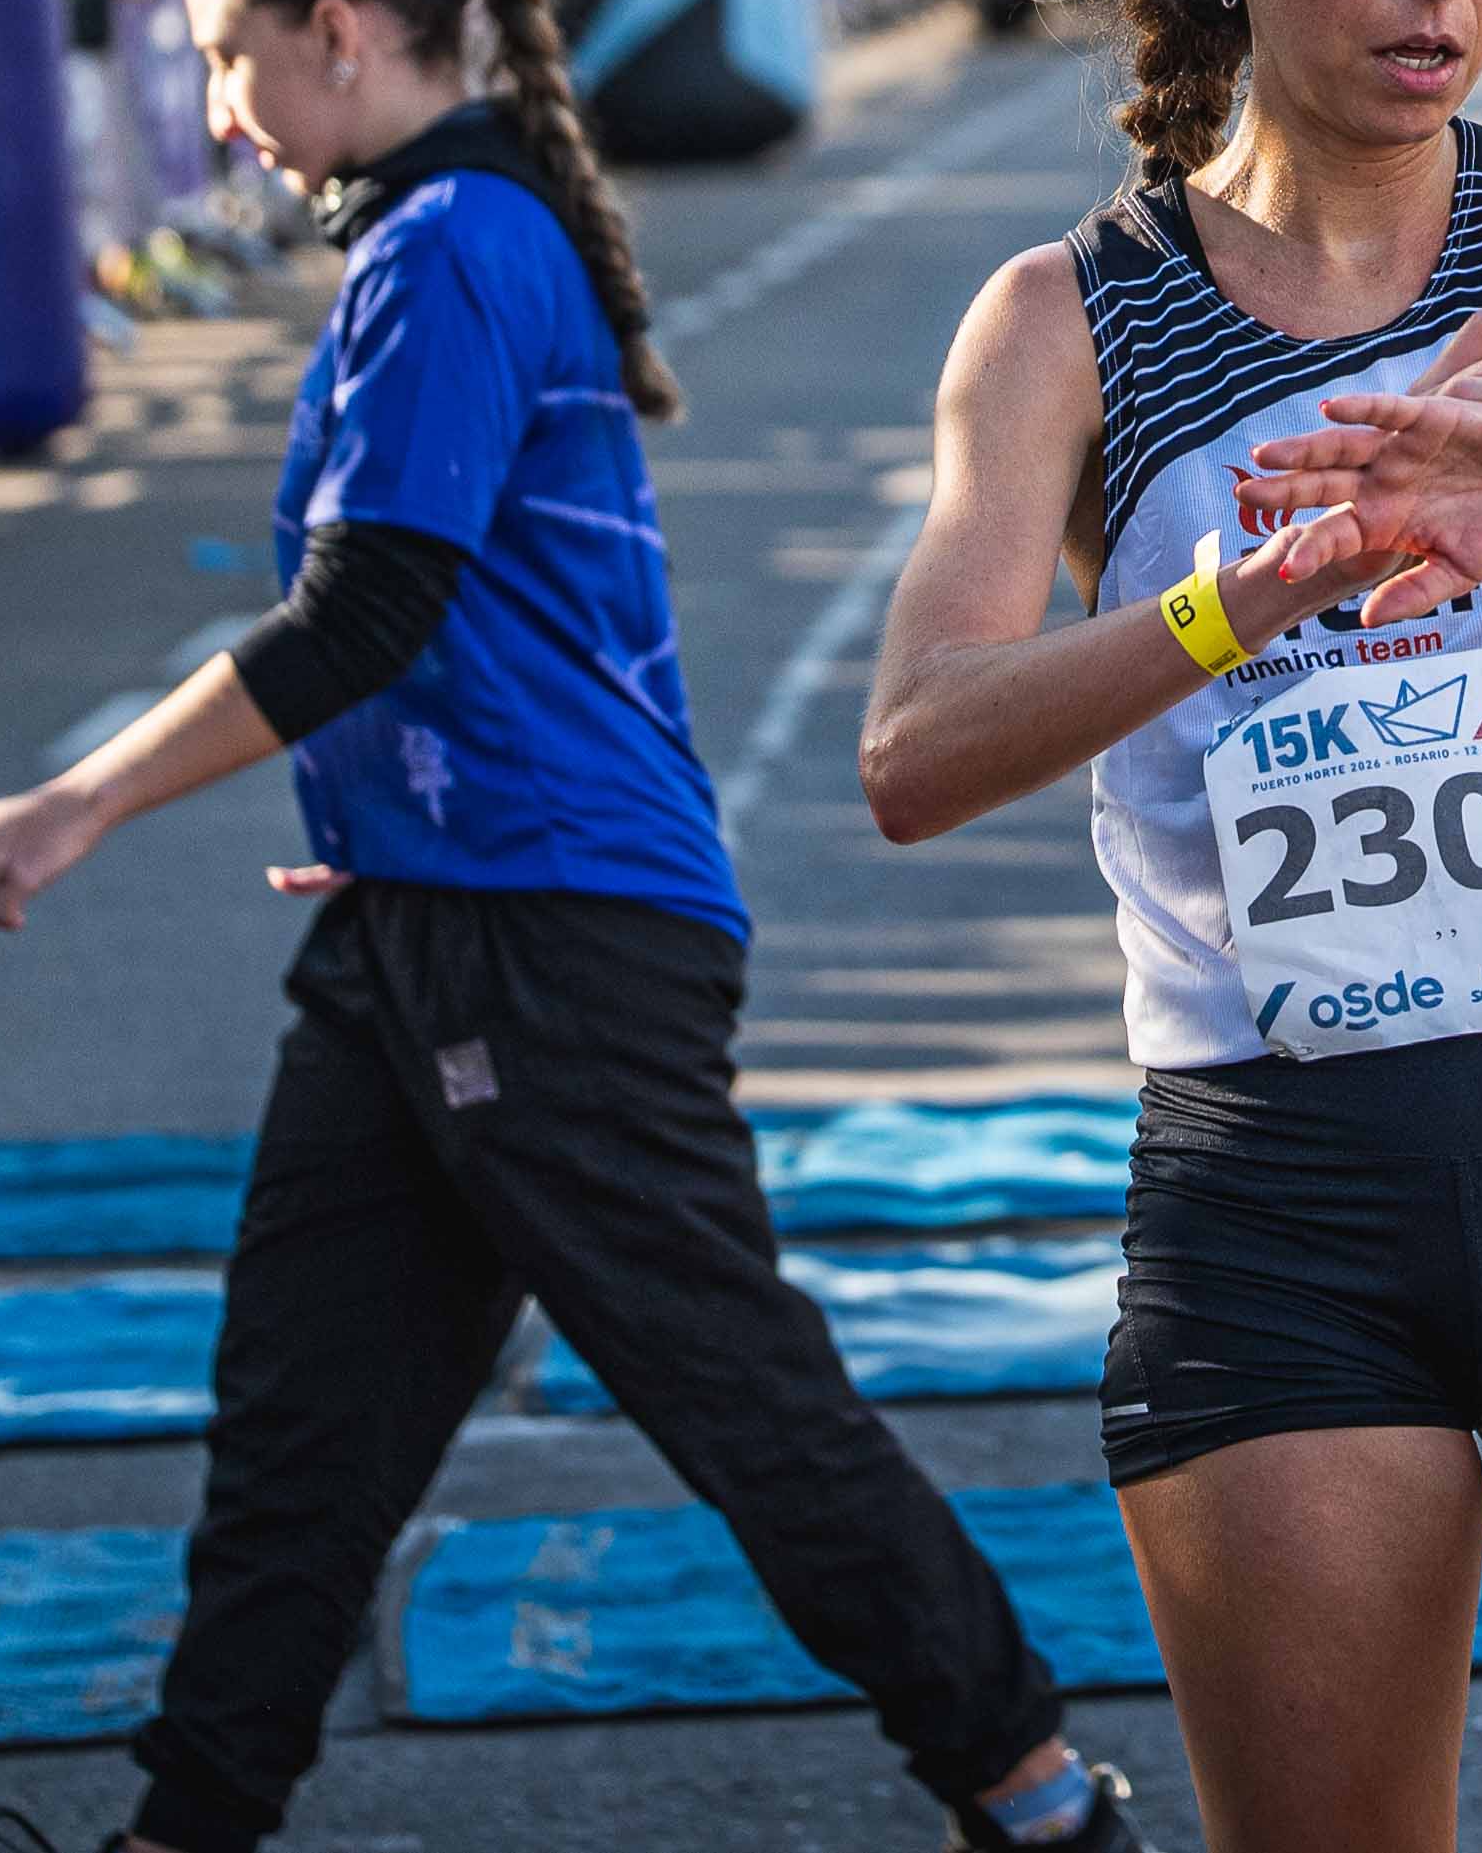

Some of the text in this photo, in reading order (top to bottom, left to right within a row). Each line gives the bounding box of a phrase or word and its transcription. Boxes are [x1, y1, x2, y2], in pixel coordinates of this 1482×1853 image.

[1168, 594, 1196, 629] B
[1223, 647, 1346, 689] running
[1355, 631, 1443, 664] team
[1242, 702, 1360, 774] 15K
[1251, 773, 1301, 794] PUERTO
[1304, 764, 1346, 782] NORTE
[1350, 758, 1381, 773] 2026
[1394, 748, 1450, 765] ROSARIO
[1464, 746, 1478, 757] 12
[1308, 969, 1445, 1031] osde
